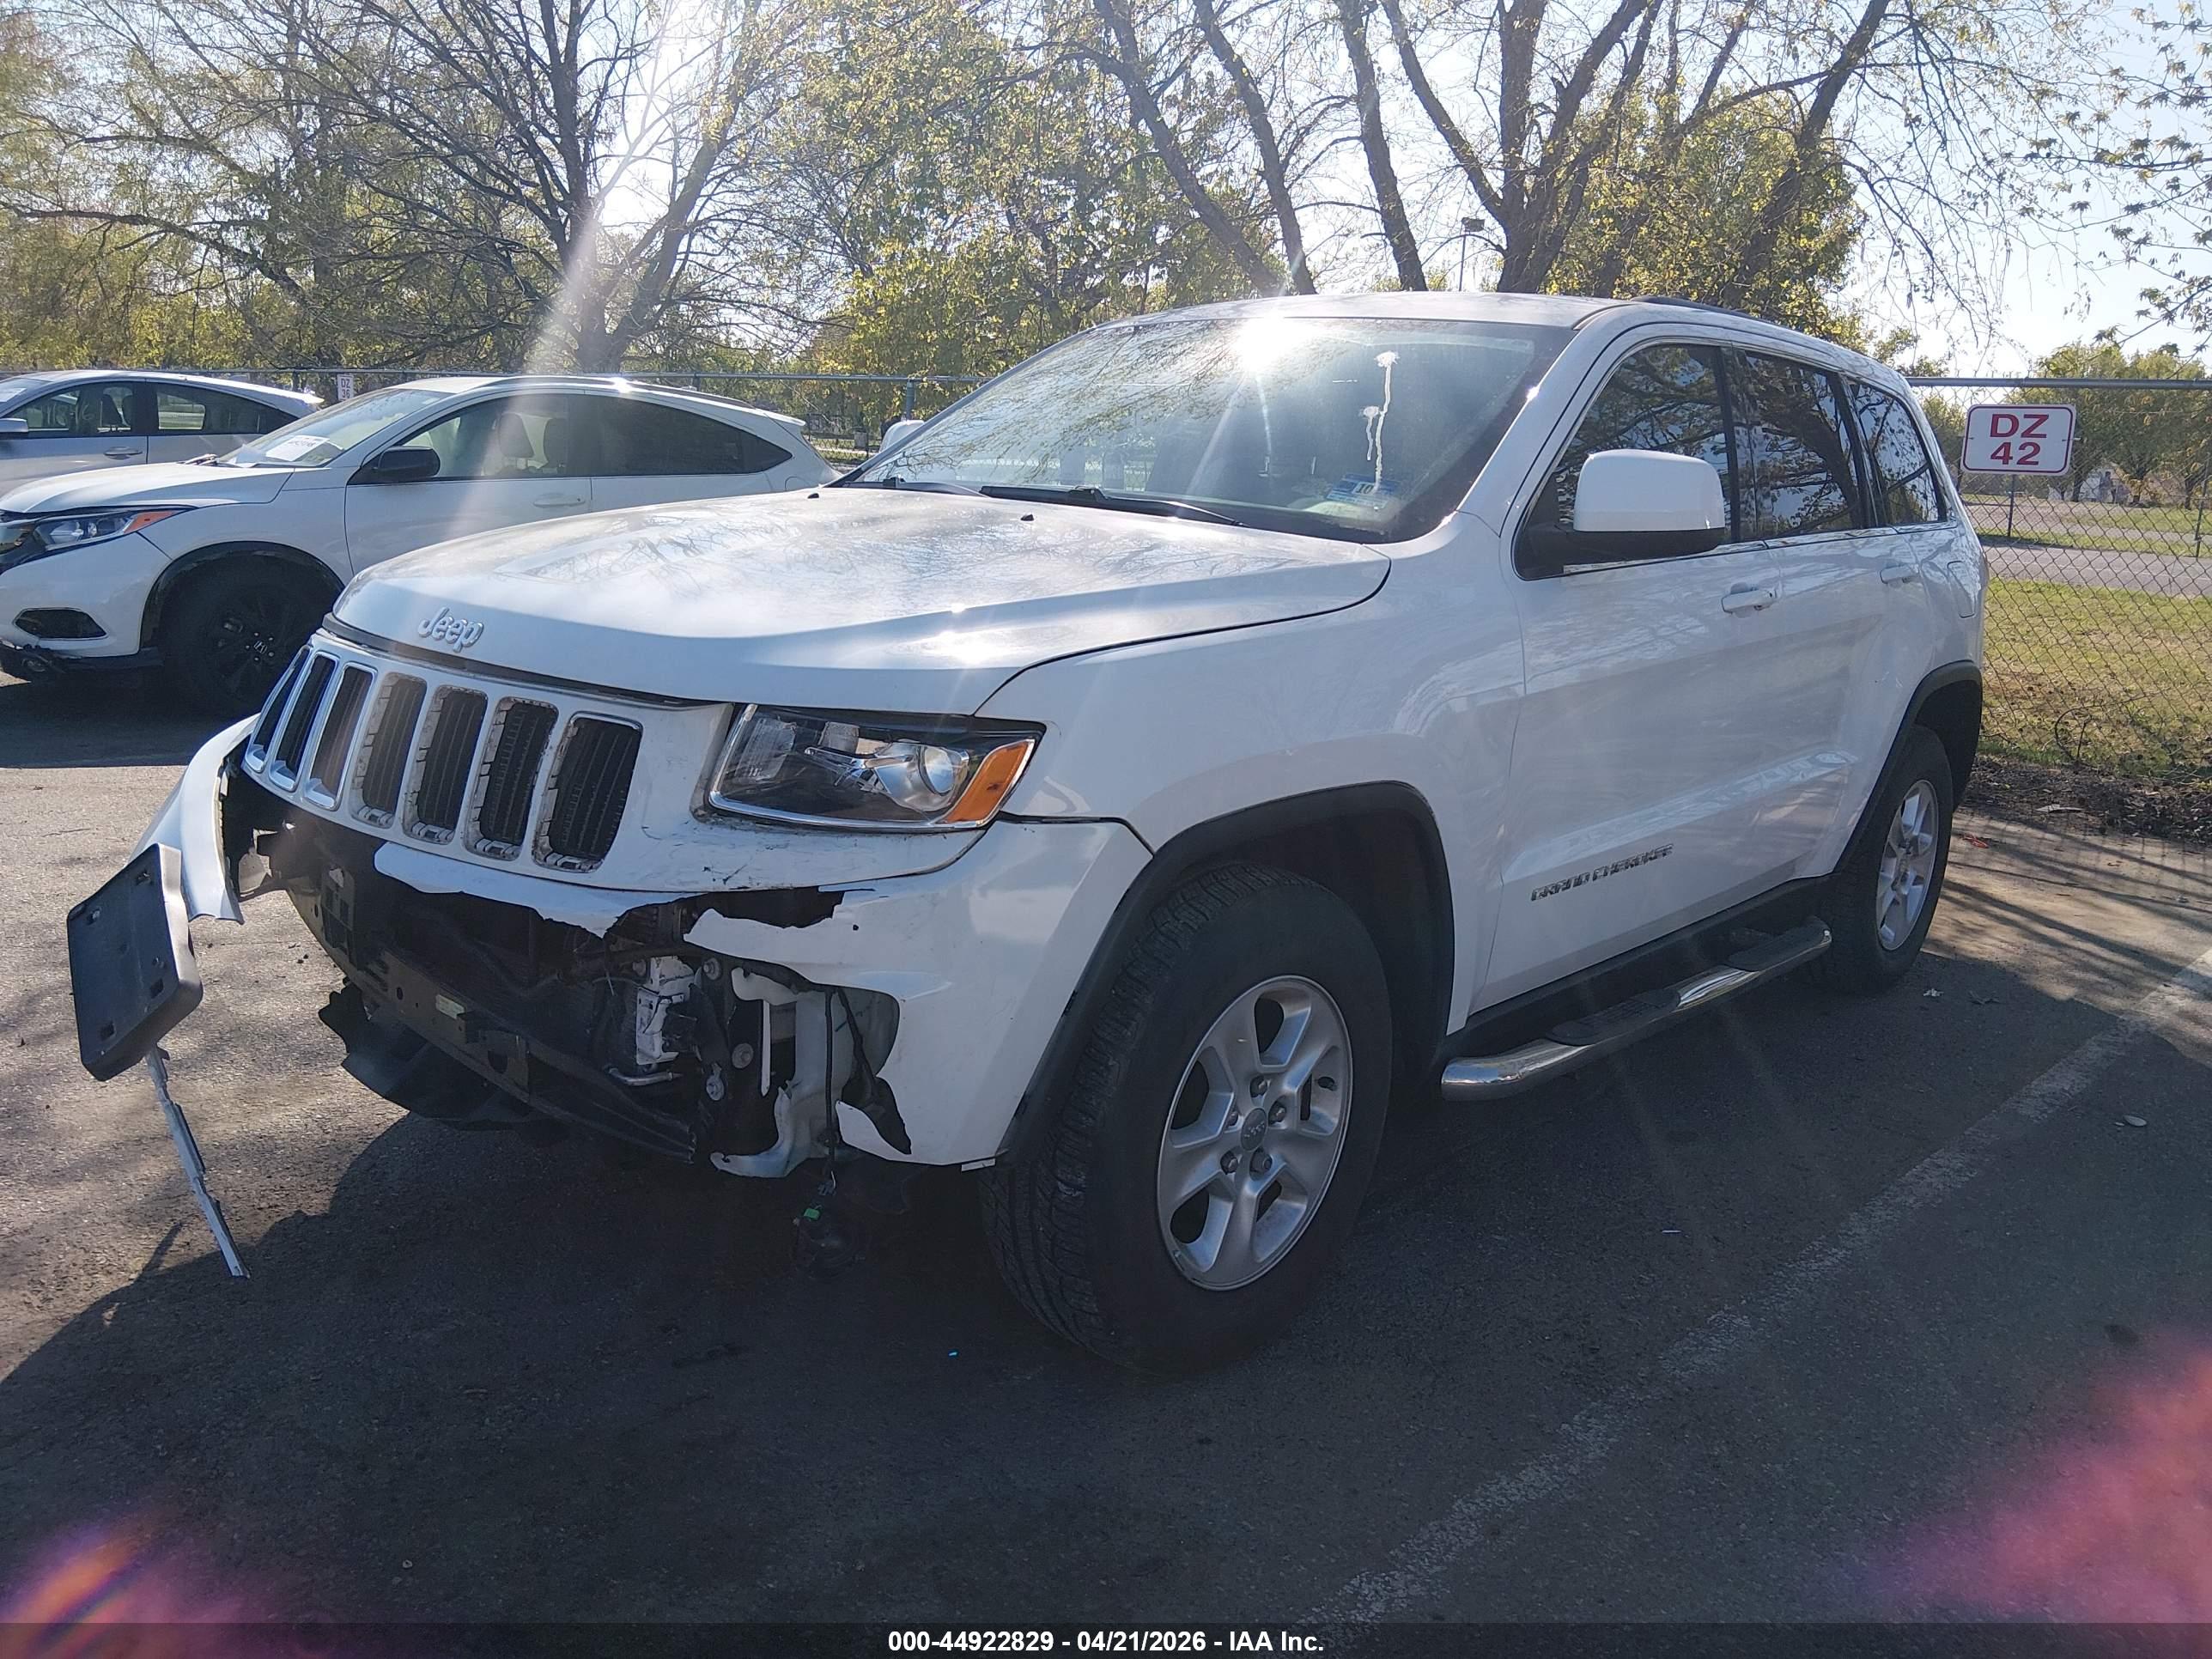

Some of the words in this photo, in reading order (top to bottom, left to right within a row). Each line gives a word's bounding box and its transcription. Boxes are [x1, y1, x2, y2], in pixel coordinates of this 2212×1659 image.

[341, 379, 350, 388] DZ
[1990, 413, 2050, 439] DZ
[1990, 441, 2041, 466] 42
[1355, 483, 1375, 495] 10
[417, 606, 484, 653] Jeep
[1531, 872, 1590, 902] GRAND
[1592, 843, 1674, 881] CHEROKEE
